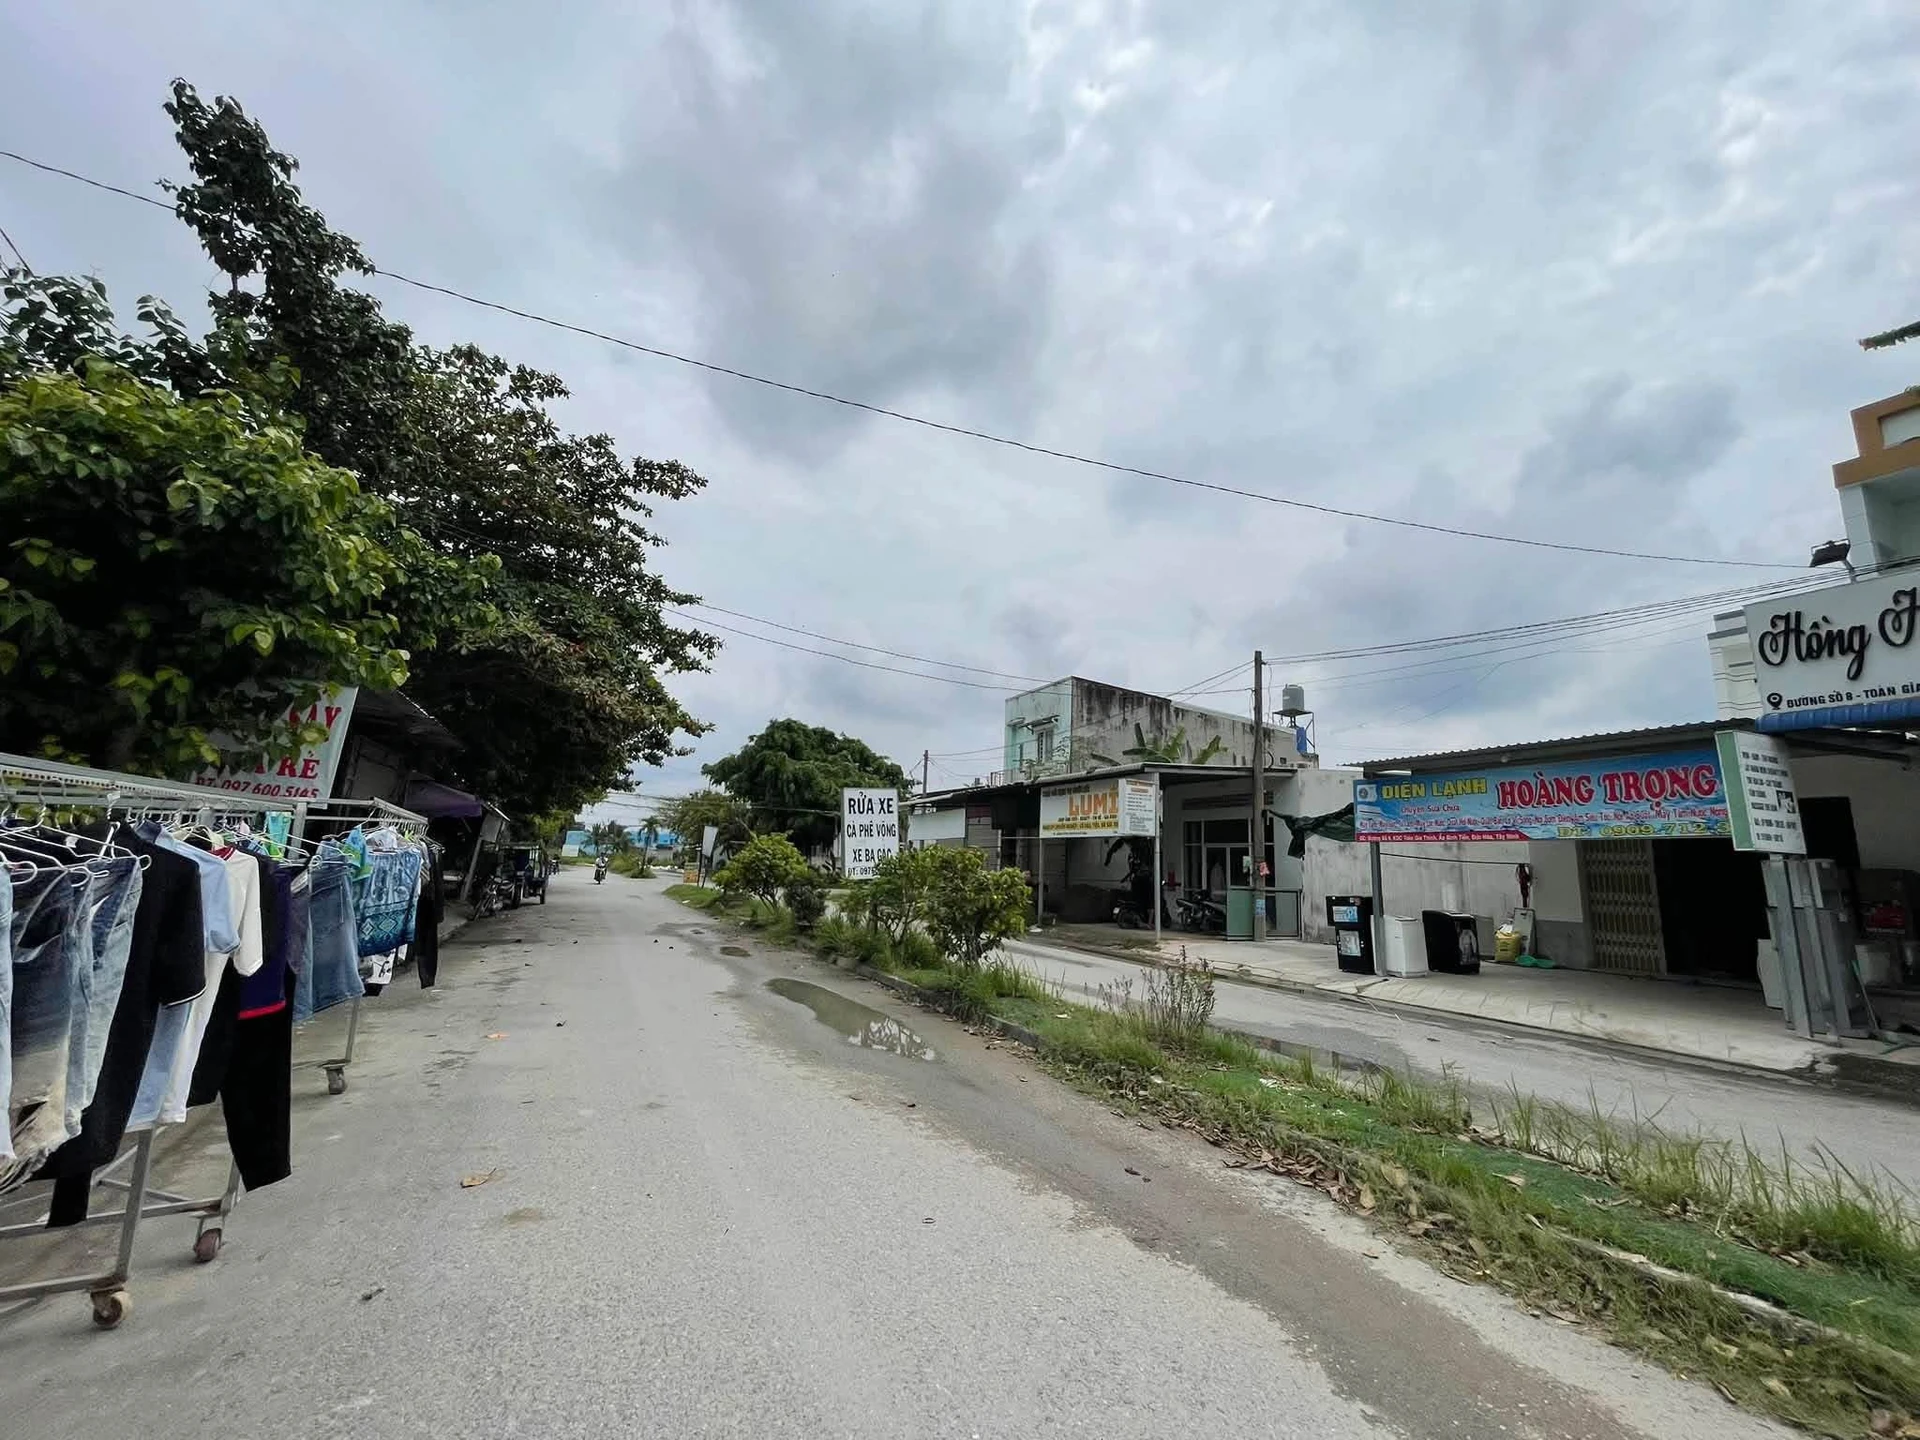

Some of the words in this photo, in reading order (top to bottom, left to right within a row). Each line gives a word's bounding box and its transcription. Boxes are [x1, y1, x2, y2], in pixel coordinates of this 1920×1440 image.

[1758, 611, 1872, 680] Hồng
[1845, 691, 1853, 701] 8
[252, 783, 281, 797] 600
[1382, 781, 1426, 801] ĐIỆN
[1432, 776, 1486, 799] LẠNH
[1497, 771, 1595, 810] HOÀNG
[1600, 764, 1718, 810] TRỌNG
[848, 791, 874, 815] RỬA
[878, 798, 894, 815] XE
[846, 820, 857, 838] CÀ
[860, 820, 874, 838] PHÊ
[852, 848, 862, 863] XE
[865, 848, 875, 862] BA
